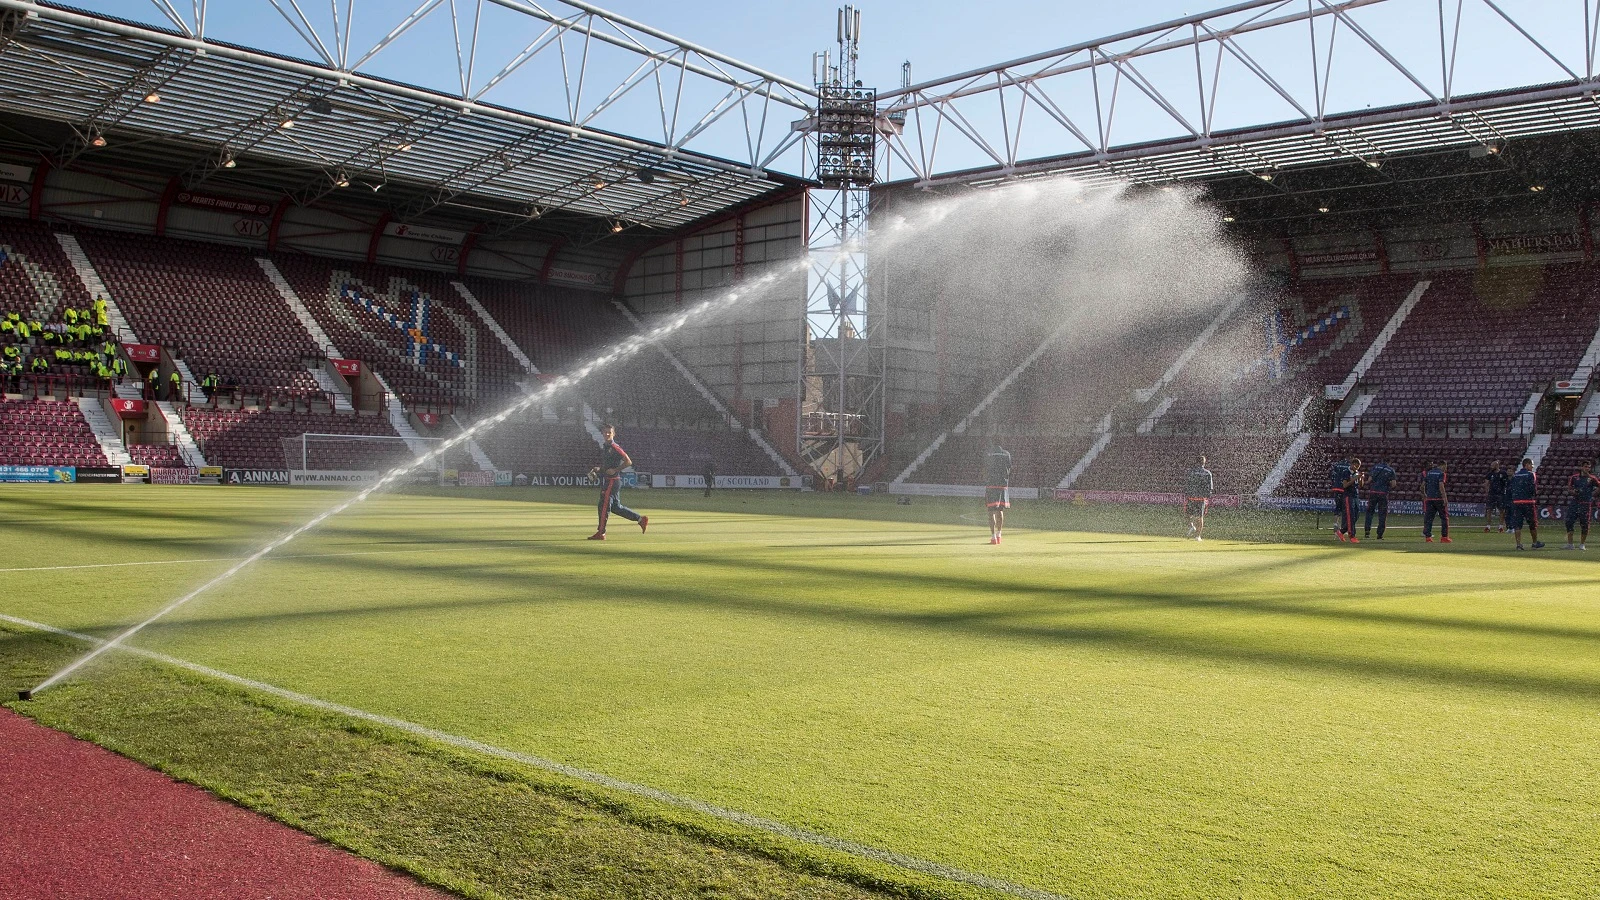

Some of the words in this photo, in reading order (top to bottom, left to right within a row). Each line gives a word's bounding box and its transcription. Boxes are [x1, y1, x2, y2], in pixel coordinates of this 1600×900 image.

[11, 187, 22, 202] X
[191, 195, 215, 206] HEARTS
[215, 199, 236, 209] FAMILY
[236, 203, 257, 212] STAND
[1488, 237, 1551, 249] MATHERS
[1553, 233, 1581, 246] BAR
[243, 471, 288, 482] ANNAN
[496, 472, 510, 481] KIT
[532, 476, 550, 486] ALL
[551, 476, 574, 486] YOU
[727, 477, 770, 487] SCOTLAND
